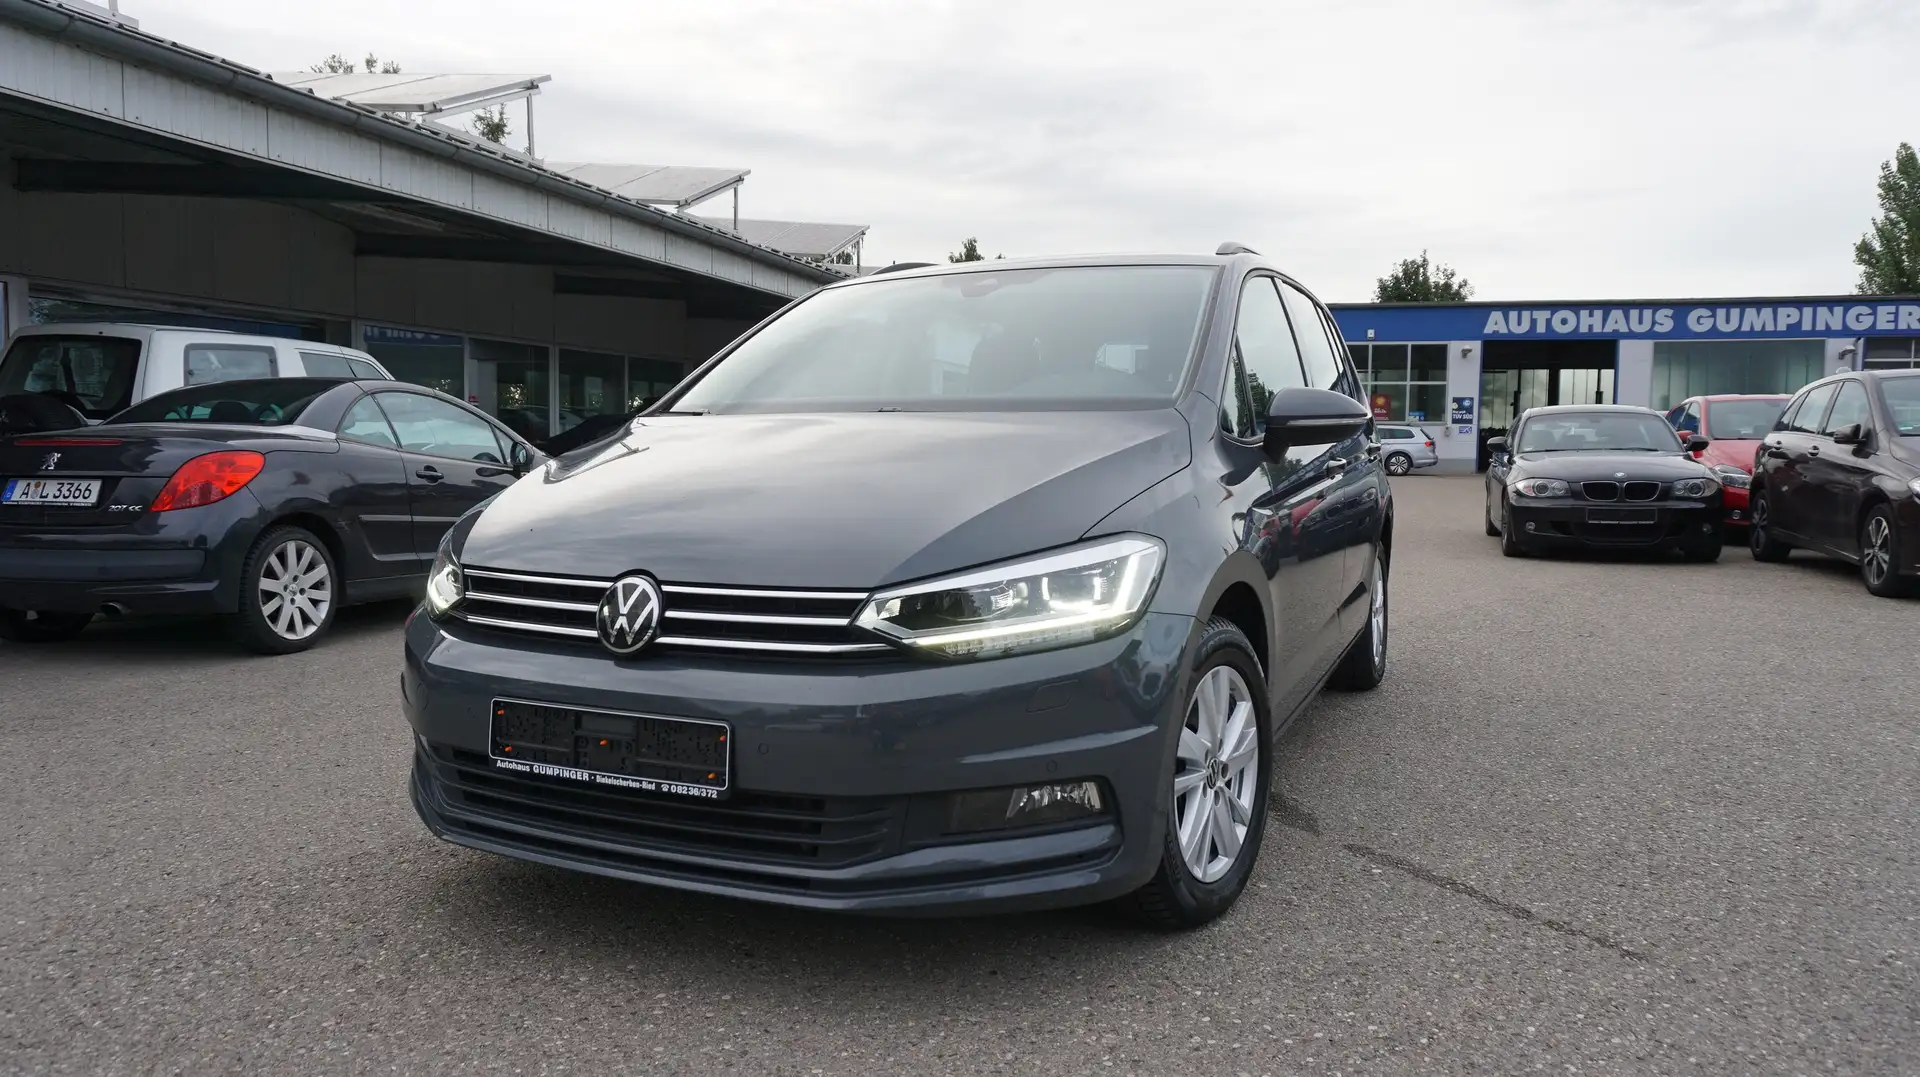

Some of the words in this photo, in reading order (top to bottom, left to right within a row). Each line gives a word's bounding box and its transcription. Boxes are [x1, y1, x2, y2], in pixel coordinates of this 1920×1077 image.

[1483, 308, 1674, 334] AUTOHAUS
[1687, 305, 1920, 333] GUMPINGER
[19, 482, 31, 498] A
[39, 482, 49, 499] L
[52, 482, 92, 500] 3366
[496, 760, 531, 772] Autohaus
[533, 765, 590, 781] GUMPINGER
[596, 775, 656, 790] Dinkelscherben-Ried
[670, 784, 718, 799] 08236/372
